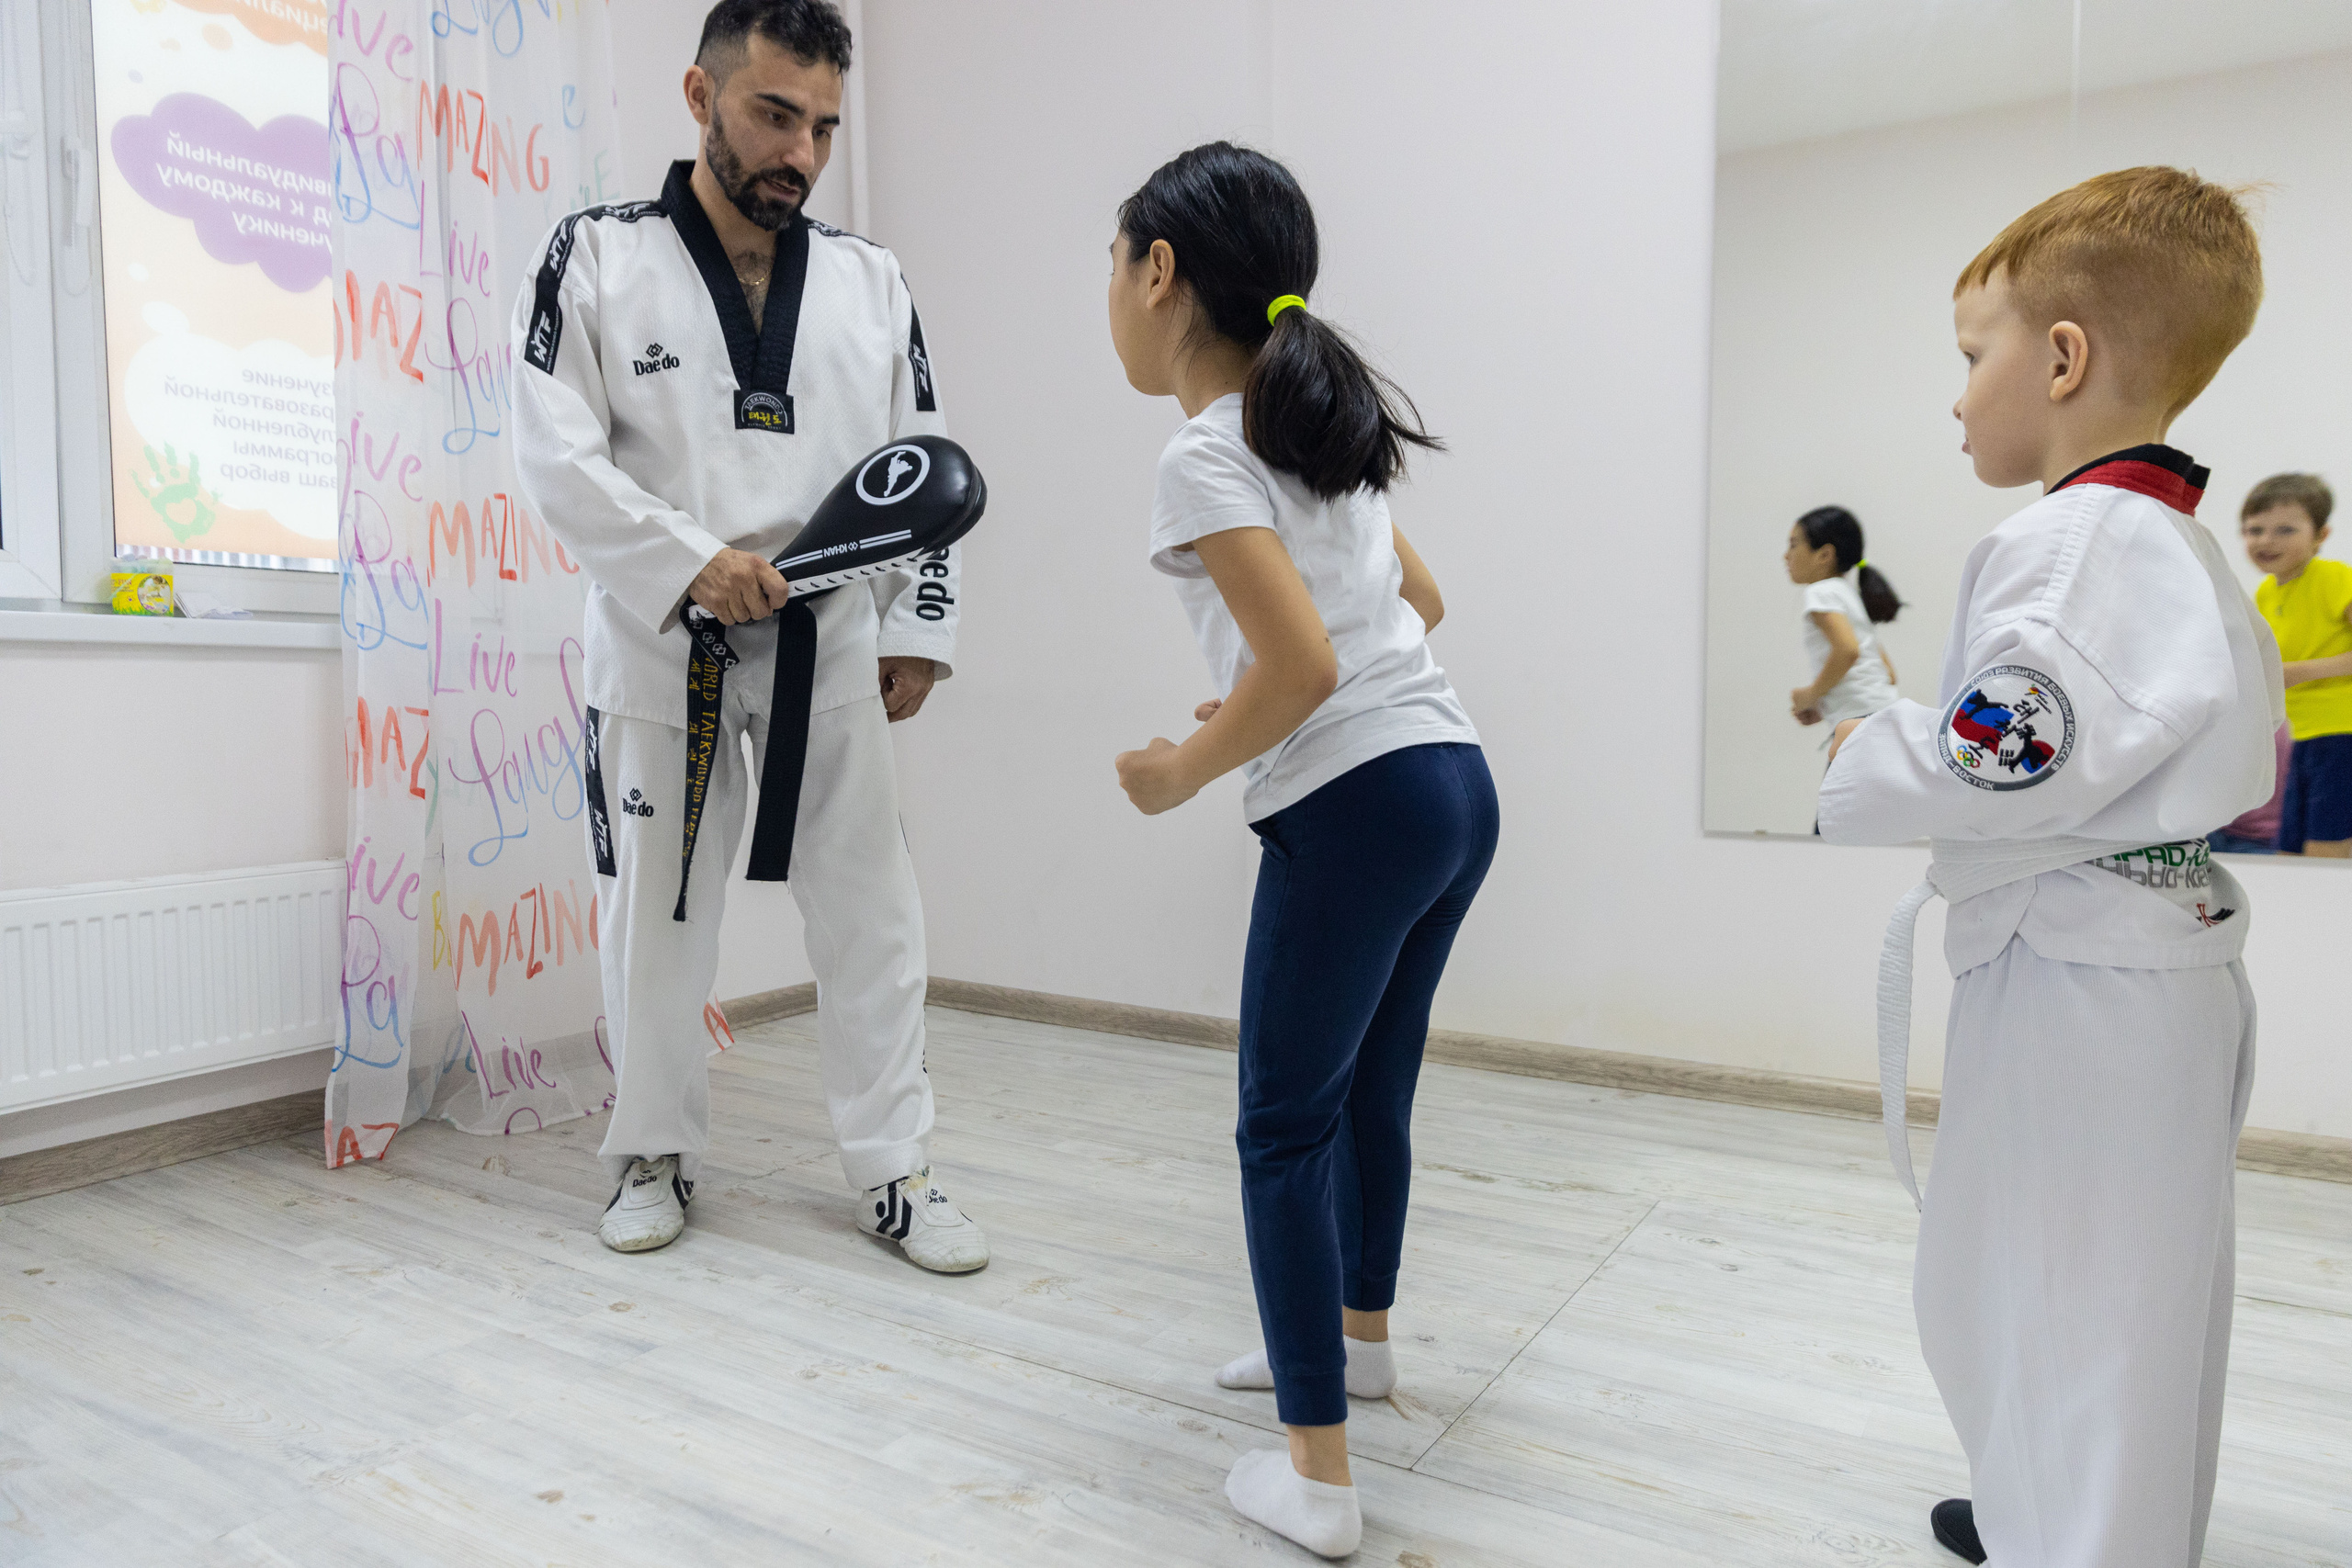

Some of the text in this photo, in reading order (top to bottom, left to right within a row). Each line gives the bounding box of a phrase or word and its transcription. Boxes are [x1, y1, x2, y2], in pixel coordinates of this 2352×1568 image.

[530, 310, 551, 364] WTF
[744, 395, 783, 415] TAEKWONDO
[823, 543, 848, 558] KHAN
[433, 597, 518, 698] Live
[702, 657, 719, 702] ORLD
[1996, 666, 2050, 686] РАЗВИТИЯ
[2047, 682, 2074, 721] БОЕВЫХ
[2051, 723, 2075, 772] ИСКУССТВ
[460, 1010, 557, 1100] Live
